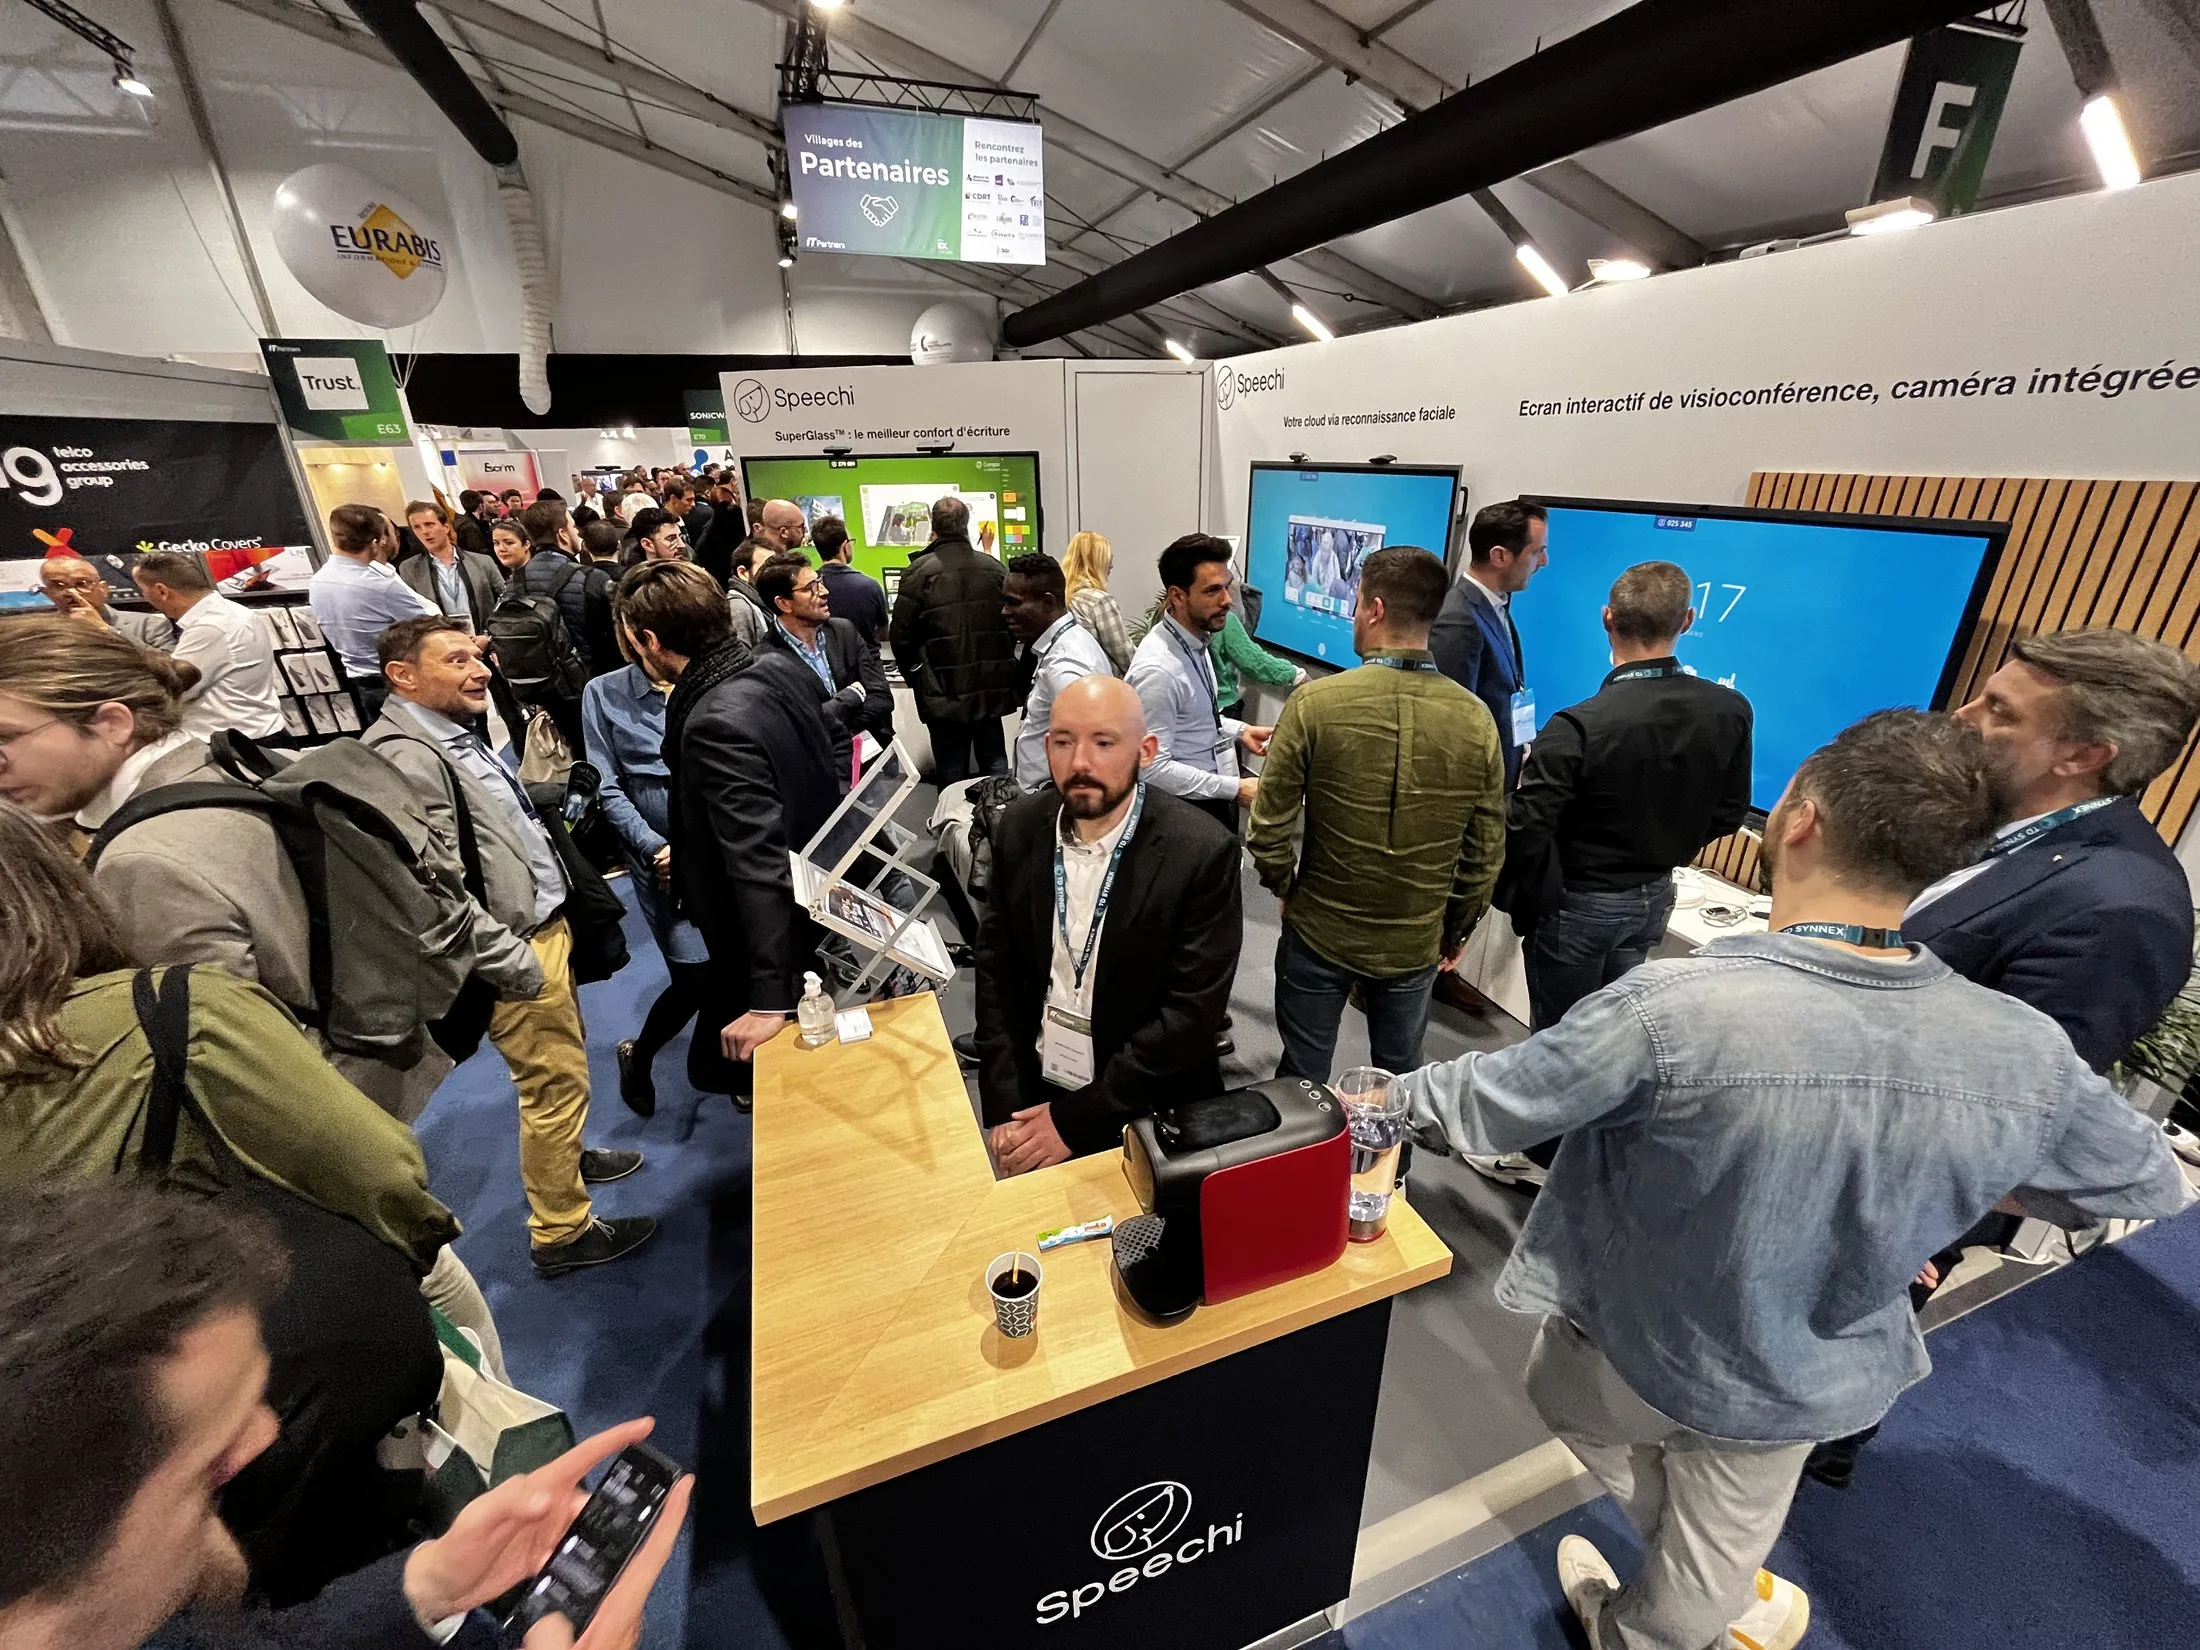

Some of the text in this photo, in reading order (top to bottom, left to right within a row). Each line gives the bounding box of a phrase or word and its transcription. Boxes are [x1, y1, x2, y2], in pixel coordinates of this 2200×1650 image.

[1909, 80, 1977, 179] F
[804, 134, 863, 149] Villages des
[974, 141, 1025, 154] Rencontrez
[975, 153, 1039, 168] les partenaires
[800, 151, 950, 187] Partenaires
[330, 225, 441, 261] EURABIS
[816, 240, 846, 249] Partners
[302, 375, 361, 391] Trust.
[1237, 367, 1285, 398] Speechi
[1519, 359, 2200, 417] Ecran interactif de visioconférence, caméra intégrée
[774, 385, 855, 412] Speechi
[1283, 405, 1456, 428] Votre cloud via reconnaissance faciale
[376, 423, 402, 434] E63
[854, 429, 864, 439] le
[866, 427, 910, 439] meilleur
[913, 426, 954, 439] confort
[956, 426, 1011, 438] d'écriture
[52, 446, 94, 458] telco
[60, 458, 150, 472] accessories
[66, 476, 114, 490] group
[1666, 519, 1693, 529] 025 345
[1696, 581, 1747, 623] 17
[2071, 797, 2113, 814] SYNNEX
[2026, 826, 2040, 836] TD
[1056, 876, 1064, 886] TD
[1098, 898, 1106, 907] TD
[1795, 925, 1845, 936] SYNNEX
[1036, 1512, 1243, 1624] Speechi
